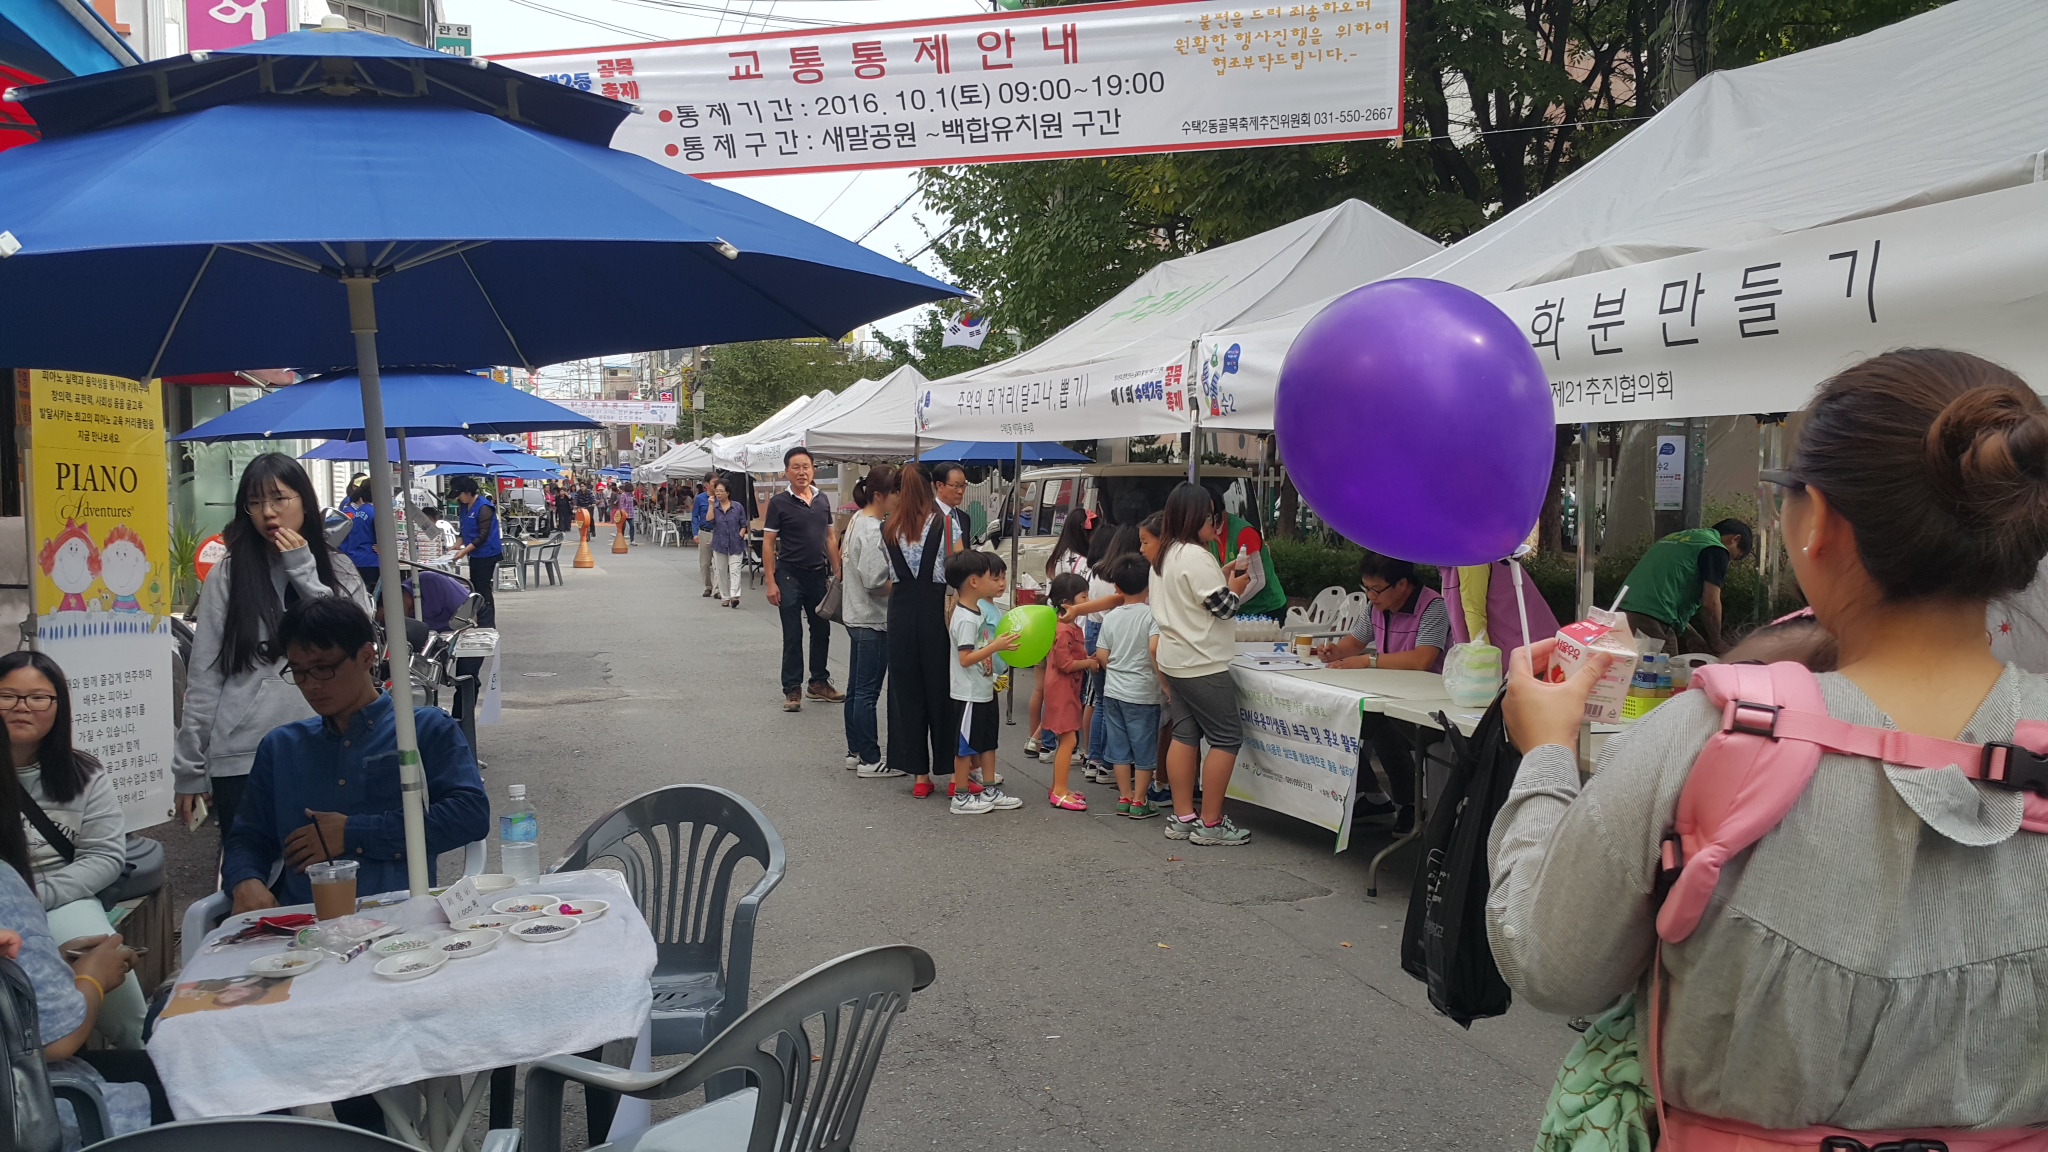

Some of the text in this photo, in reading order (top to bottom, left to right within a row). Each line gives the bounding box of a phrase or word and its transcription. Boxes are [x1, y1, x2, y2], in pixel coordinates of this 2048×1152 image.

[1289, 0, 1371, 23] 죄송하오며
[1174, 20, 1389, 55] 원활한 행사진행을 위하여
[597, 58, 634, 77] 골목
[601, 81, 640, 101] 축제
[998, 70, 1165, 104] 09:00~19:00
[821, 121, 918, 152] 새말공원
[1071, 107, 1122, 137] 구간
[1181, 107, 1394, 135] 수택2동골목축제추진위원회 031-550-2667
[42, 370, 63, 383] 피아노
[65, 373, 84, 386] 실력과
[1164, 363, 1183, 387] 골목
[957, 388, 982, 416] 추억의
[1165, 389, 1184, 412] 축제
[39, 407, 73, 421] 발달시키는
[74, 411, 93, 423] 최고의
[94, 413, 111, 425] 피아노
[78, 429, 91, 442] 지금
[55, 462, 138, 494] PIANO
[82, 675, 98, 689] 함께
[100, 672, 122, 687] 즐겁게
[124, 669, 153, 683] 연주하며
[83, 689, 132, 706] 배우는 피아노!
[70, 703, 146, 726] 구라도 음악에 흥미를
[78, 729, 94, 743] 가질
[96, 729, 104, 741] 수
[1292, 722, 1310, 741] 보급
[1310, 726, 1323, 745] 및
[1323, 728, 1340, 747] 홍보
[101, 743, 124, 756] 개발과
[126, 739, 140, 753] 함께
[106, 759, 128, 774] 골고루
[149, 768, 164, 783] 함께
